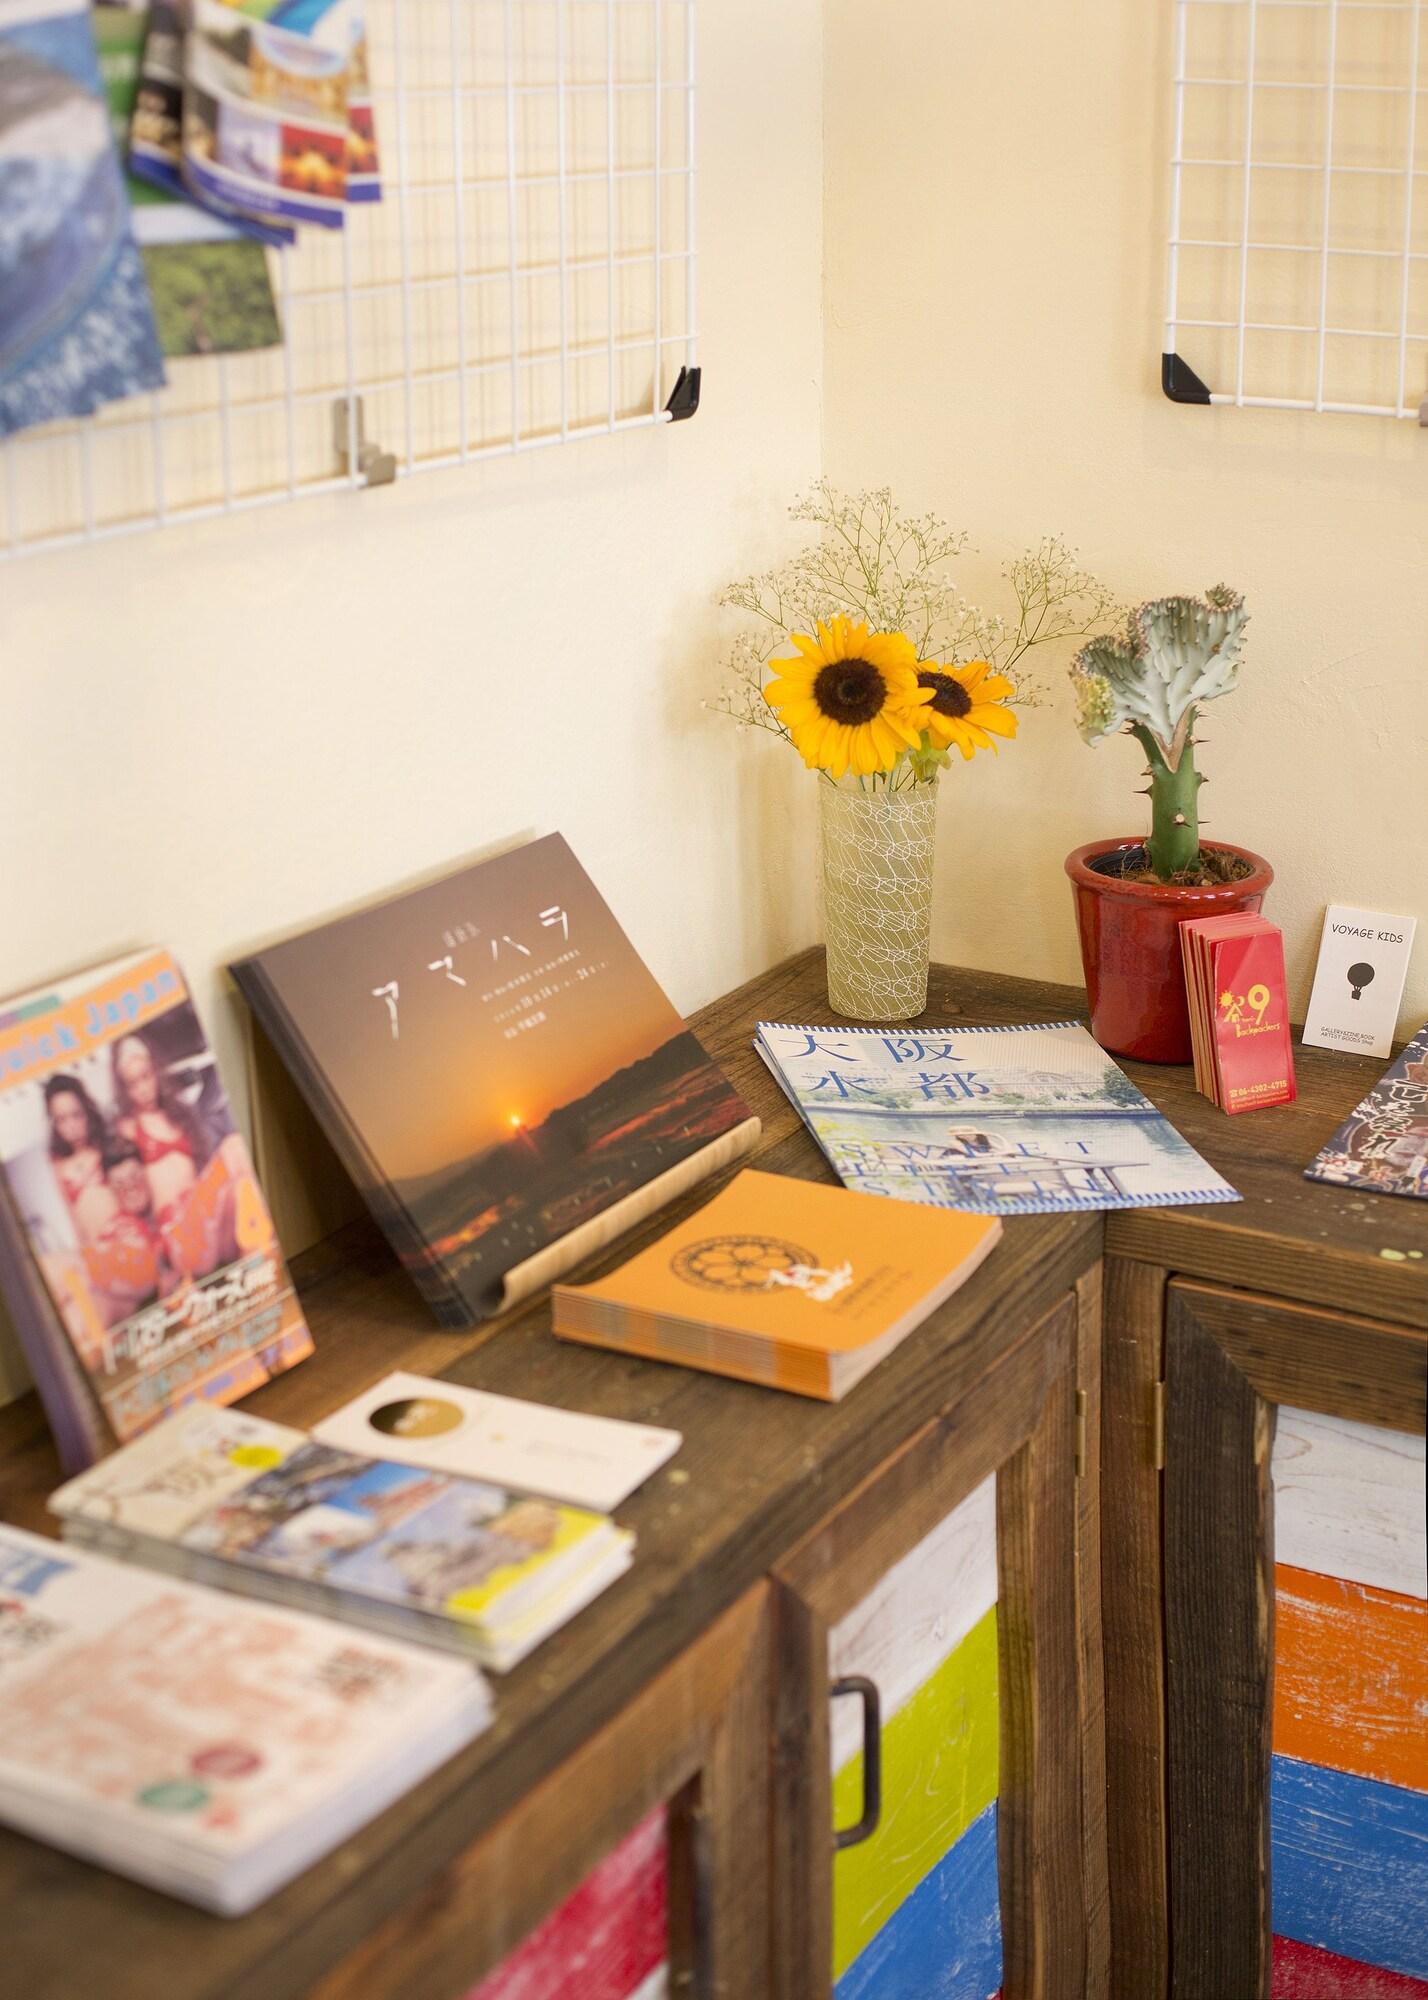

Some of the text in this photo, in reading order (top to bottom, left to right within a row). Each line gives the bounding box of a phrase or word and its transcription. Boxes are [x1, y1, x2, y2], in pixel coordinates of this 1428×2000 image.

[1332, 923, 1404, 944] VOYAGE KIDS
[779, 1034, 968, 1063] 大阪
[802, 1070, 991, 1100] 水都
